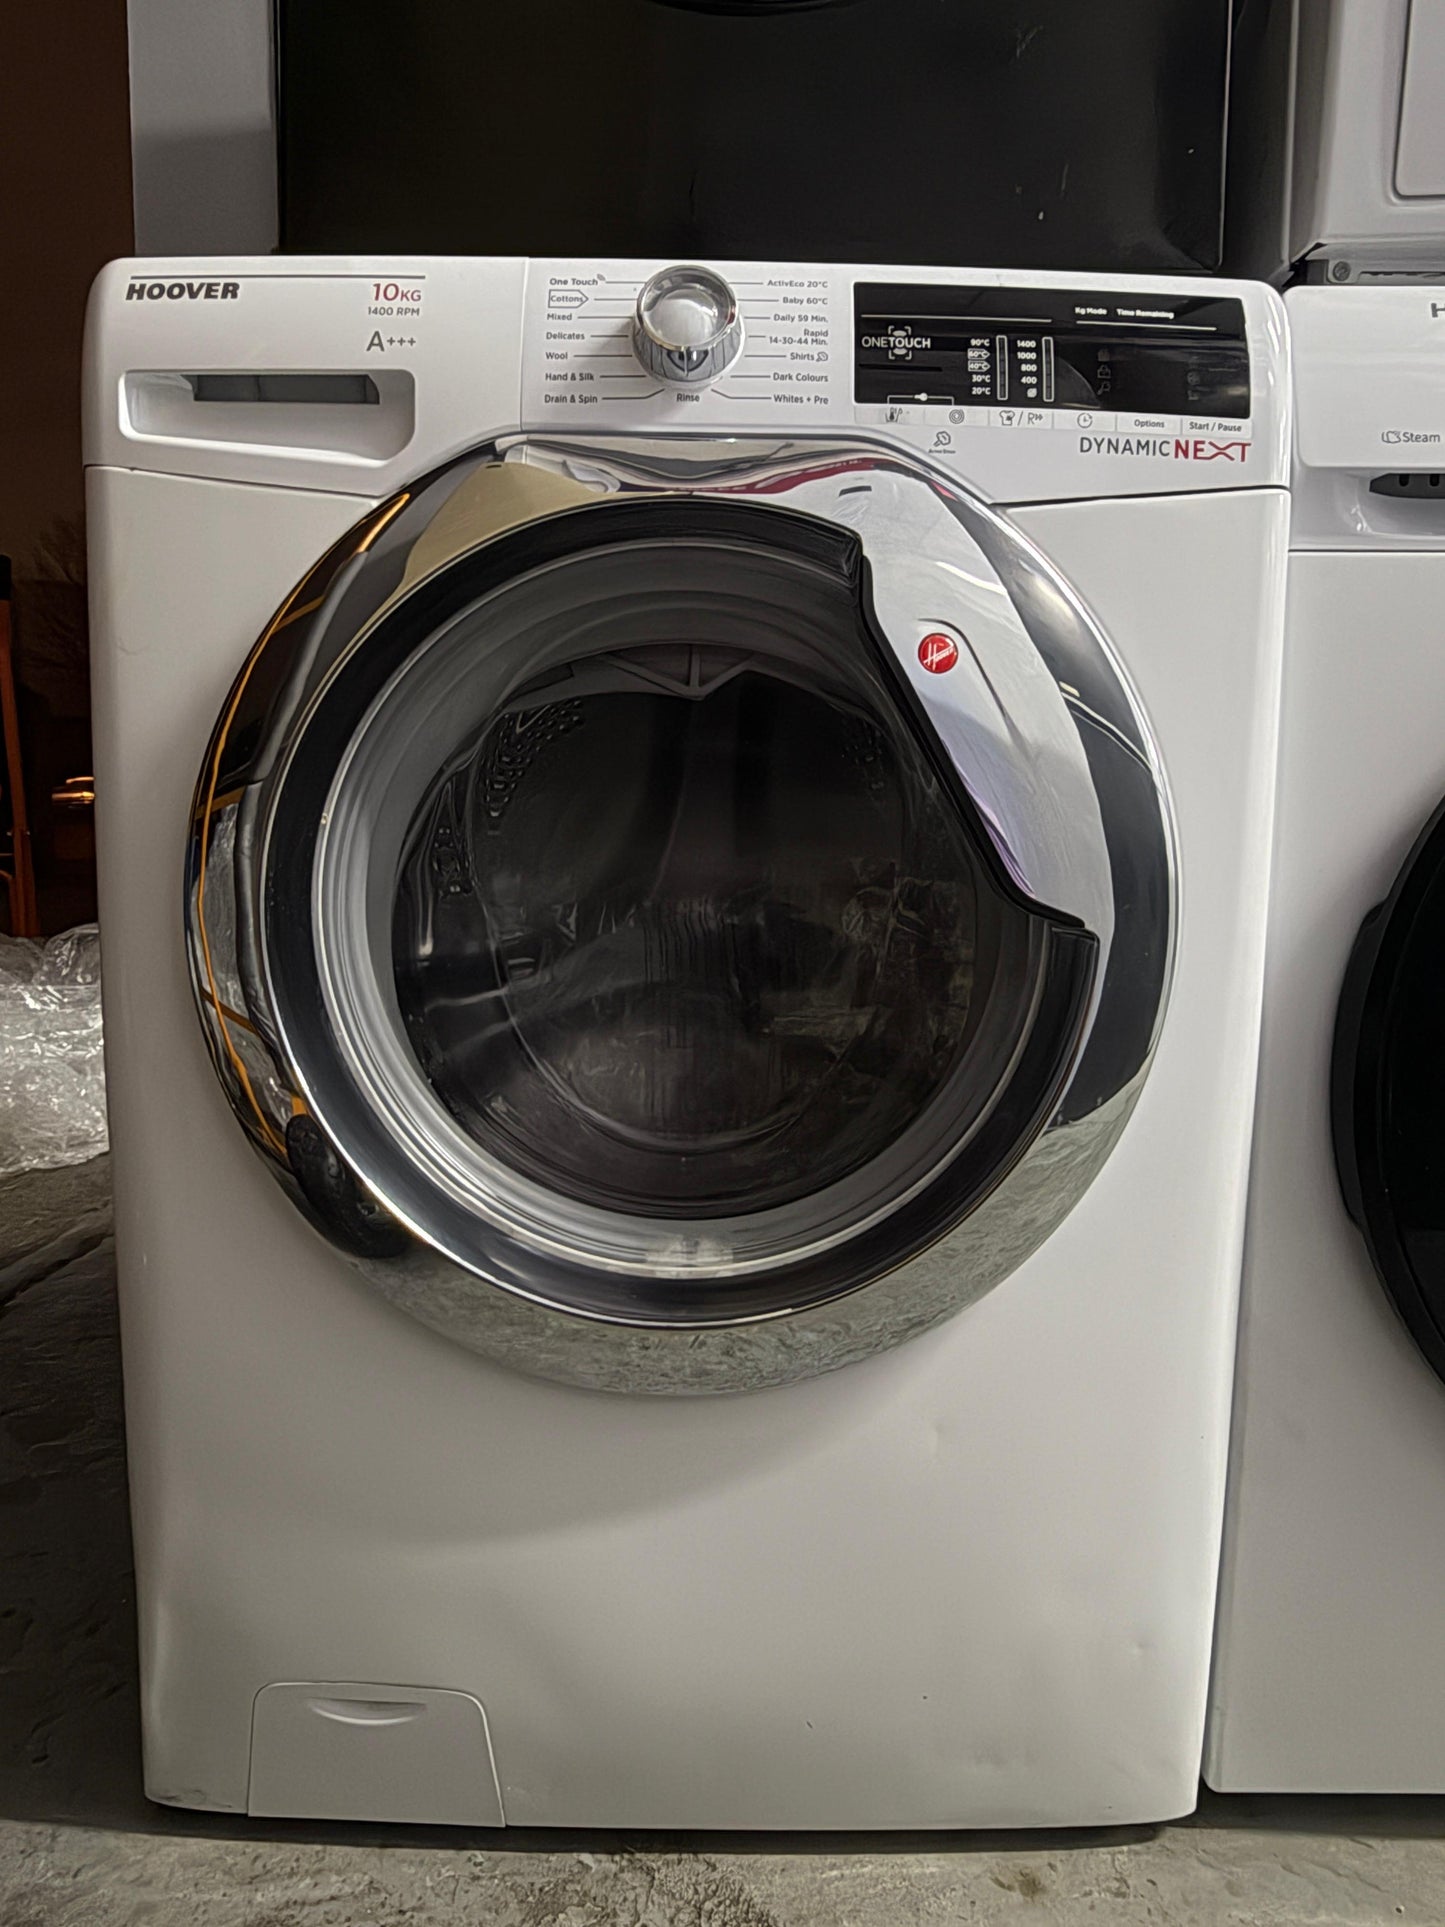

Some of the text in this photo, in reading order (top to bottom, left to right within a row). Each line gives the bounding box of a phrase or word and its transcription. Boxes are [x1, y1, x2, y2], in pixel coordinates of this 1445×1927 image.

[549, 277, 598, 286] One Touch
[767, 279, 804, 288] ActivEco
[125, 281, 242, 300] HOOVER
[371, 282, 422, 301] 10KG
[550, 294, 584, 303] Cottons
[782, 296, 804, 305] Baby
[367, 306, 422, 316] 1400 RPM
[1087, 307, 1108, 315] Mode
[1116, 308, 1134, 316] Time
[1135, 309, 1174, 319] Remaining
[546, 312, 572, 321] Mixed
[773, 313, 828, 323] Daily 59 Min.
[545, 331, 586, 340] Delicates
[803, 328, 828, 337] Rapid
[366, 330, 418, 352] A+++
[769, 336, 828, 346] 14-30-44 Min.
[1016, 339, 1036, 348] 1400
[545, 351, 568, 360] Wool
[789, 351, 814, 361] Shirts
[1016, 351, 1036, 360] 1000
[1020, 363, 1038, 372] 800
[544, 372, 568, 381] Hand
[578, 372, 594, 381] Silk
[772, 372, 828, 382] Dark Colours
[1020, 375, 1038, 384] 400
[544, 393, 568, 403] Drain
[578, 393, 598, 405] Spin
[676, 392, 700, 403] Rinse
[772, 393, 804, 403] Whites
[813, 395, 828, 405] Pre
[1133, 418, 1164, 429] Options
[1188, 420, 1210, 431] Start
[1217, 422, 1242, 433] Pause
[1402, 430, 1440, 444] Steam
